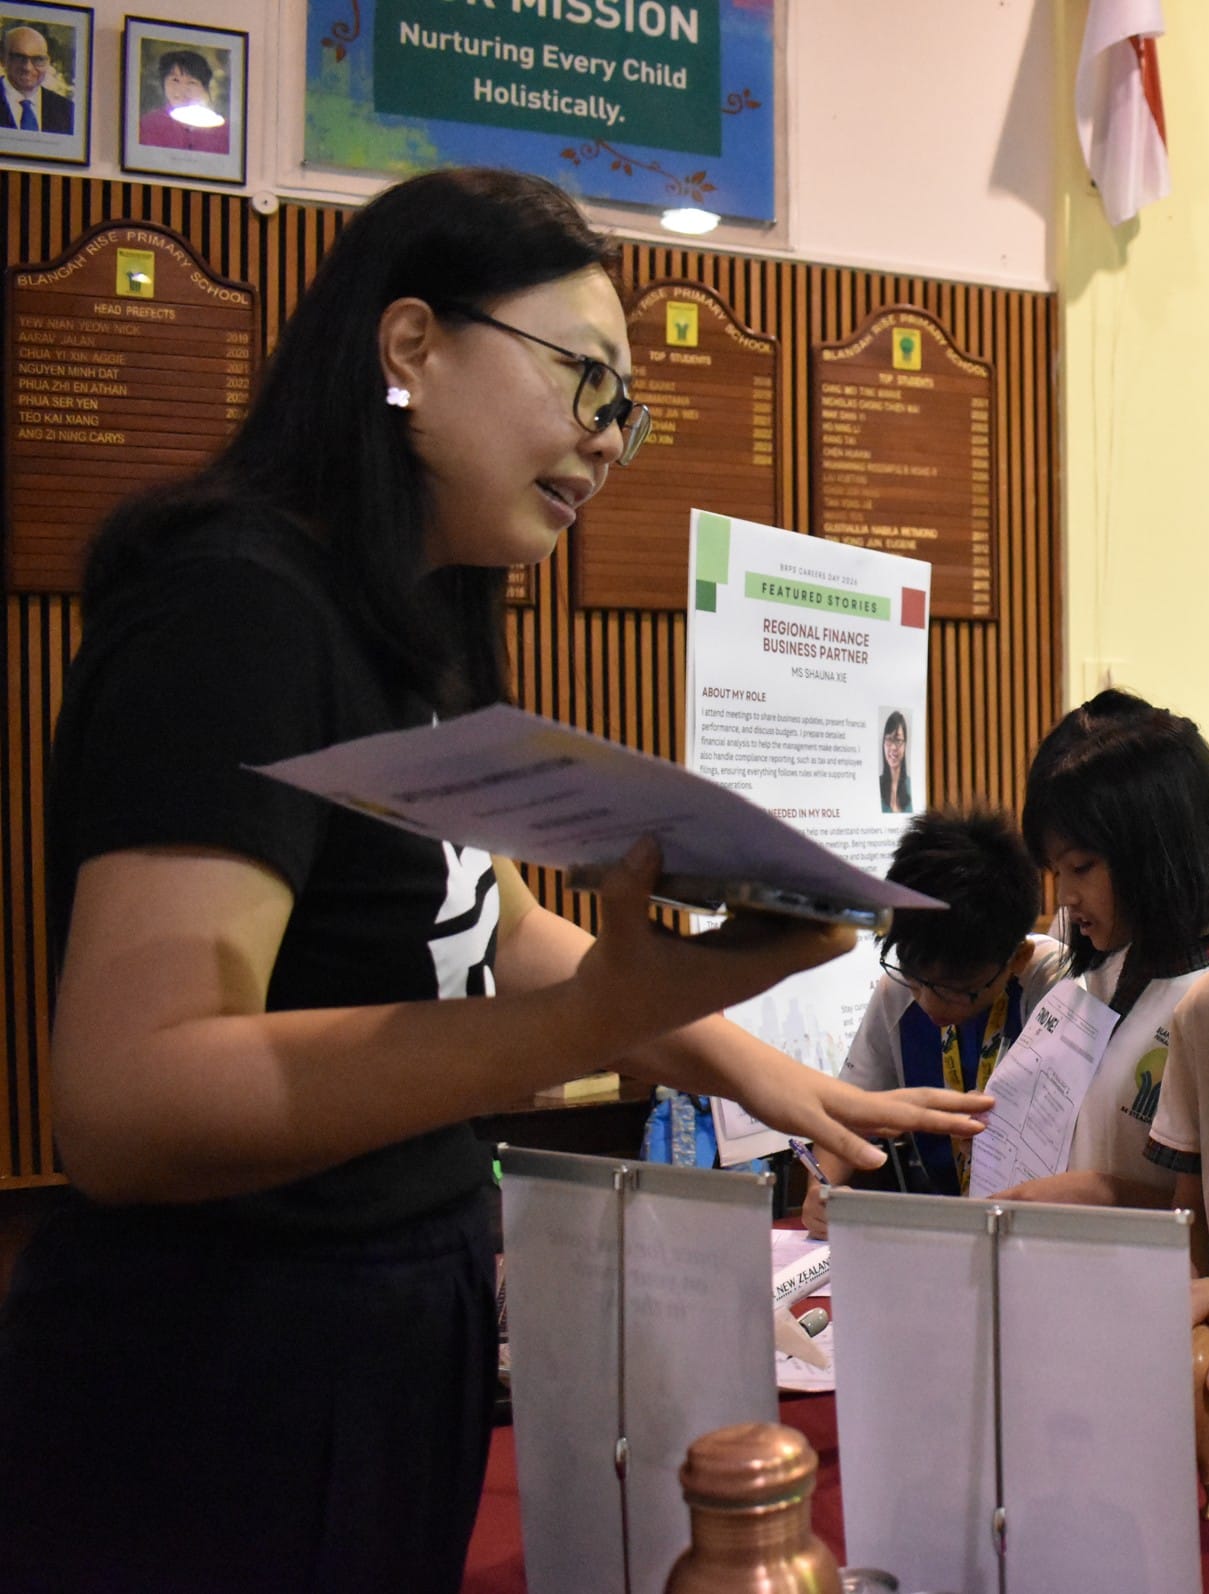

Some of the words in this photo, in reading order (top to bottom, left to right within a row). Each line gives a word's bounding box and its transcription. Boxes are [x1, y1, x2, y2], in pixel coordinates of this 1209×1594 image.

[399, 21, 535, 69] Nurturing
[542, 45, 616, 82] Every
[623, 58, 687, 90] Child
[474, 77, 625, 126] Holistically.
[17, 254, 88, 287] BLANGAH
[86, 231, 119, 256] RISE
[126, 231, 192, 267] PRIMARY
[190, 271, 249, 305] SCHOOL
[94, 304, 122, 316] HEAD
[126, 305, 176, 320] PREFECTS
[639, 288, 668, 310] RISE
[673, 287, 727, 320] PRIMARY
[724, 322, 771, 352] SCHOOL
[20, 347, 51, 359] CHUA
[822, 334, 873, 362] BLANGAH
[871, 313, 896, 335] RISE
[900, 313, 947, 346] PRIMARY
[945, 347, 988, 378] SCHOOL
[650, 350, 666, 361] TOP
[669, 352, 712, 366] STUDENTS
[19, 363, 65, 376] NGUYEN
[68, 366, 96, 377] MINH
[98, 368, 119, 379] DAT
[19, 378, 50, 391] PHUA
[51, 380, 70, 392] ZHI
[73, 382, 88, 393] EN
[90, 383, 127, 396] ATHAN
[19, 394, 50, 407] PHUA
[51, 396, 74, 409] SER
[76, 398, 98, 410] YEN
[19, 411, 41, 424] TEO
[44, 412, 62, 425] KAI
[65, 414, 99, 426] XIANG
[18, 427, 42, 440] ANG
[46, 428, 56, 440] ZI
[58, 430, 87, 442] NING
[89, 431, 125, 445] CARYS
[780, 562, 797, 575] BRPS
[798, 567, 827, 580] CAREERS
[828, 573, 841, 582] DAY
[761, 582, 823, 604] FEATURED
[827, 595, 879, 614] STORIES
[763, 618, 820, 640] REGIONAL
[823, 629, 870, 648] FINANCE
[763, 637, 817, 659] BUSINESS
[820, 647, 869, 665] PARTNER
[791, 667, 803, 678] MS
[804, 668, 836, 683] SHAUNA
[836, 671, 848, 683] XIE
[702, 687, 730, 699] ABOUT
[732, 689, 745, 700] MY
[746, 690, 767, 703] ROLE
[704, 708, 725, 719] attend
[726, 709, 753, 722] meetings
[753, 711, 760, 720] to
[761, 712, 776, 722] share
[777, 713, 801, 725] business
[825, 717, 844, 729] present
[846, 718, 866, 729] financial
[701, 722, 739, 735] performance,
[742, 724, 753, 734] and
[754, 725, 775, 736] discuss
[775, 727, 799, 739] budgets.
[803, 730, 824, 741] prepare
[701, 736, 725, 747] financial
[726, 737, 751, 750] analysis
[751, 739, 758, 748] to
[758, 740, 771, 751] help
[772, 740, 781, 750] the
[782, 742, 817, 754] management
[818, 743, 832, 753] make
[700, 751, 713, 761] also
[713, 752, 734, 763] handle
[735, 753, 768, 766] compliance
[769, 755, 796, 767] reporting,
[796, 756, 810, 766] such
[827, 757, 837, 767] and
[837, 758, 862, 768] employee
[720, 767, 746, 779] ensuring
[747, 766, 777, 780] everything
[778, 767, 798, 778] follows
[798, 769, 812, 779] rules
[813, 769, 827, 779] while
[828, 770, 856, 781] supporting
[768, 808, 797, 818] NEEDED
[799, 808, 807, 818] IN
[808, 809, 821, 818] MY
[822, 808, 840, 818] ROLE
[806, 828, 818, 837] help
[829, 827, 860, 836] understand
[825, 840, 851, 850] meetings.
[849, 853, 860, 861] and
[776, 1277, 796, 1295] NEW
[798, 1256, 831, 1284] ZEALAN
